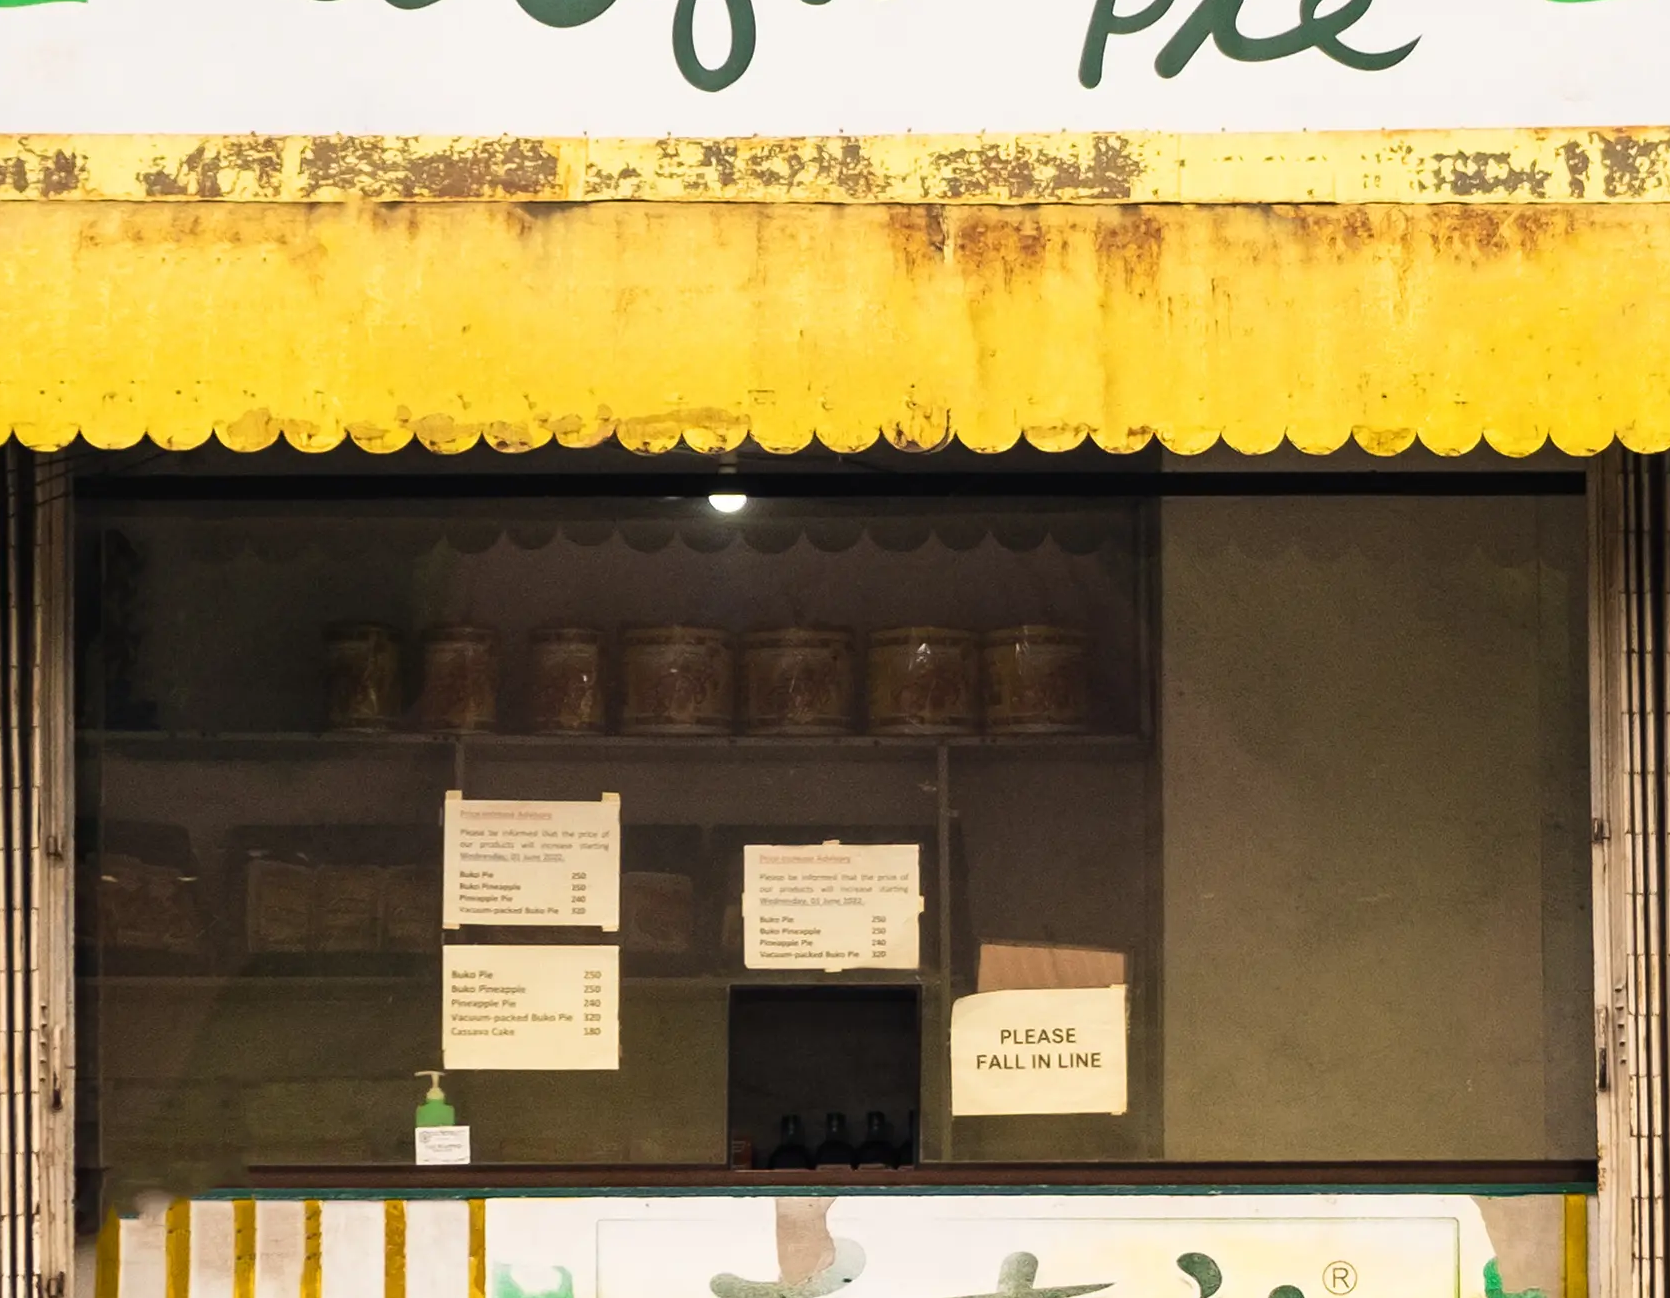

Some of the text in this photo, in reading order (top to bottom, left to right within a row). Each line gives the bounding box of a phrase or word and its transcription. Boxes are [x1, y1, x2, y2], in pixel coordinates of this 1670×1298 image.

[451, 971, 601, 979] Buko Pie 250
[451, 985, 601, 994] Buko Pineapple 250
[451, 999, 601, 1008] Pineapple Pie 240
[451, 1014, 529, 1022] Vacuum-packed
[531, 1014, 555, 1022] Buko
[558, 1014, 573, 1022] Pie
[492, 1028, 515, 1036] Cake
[584, 1028, 601, 1036] 180
[1000, 1028, 1076, 1045] PLEASE
[976, 1052, 1102, 1070] FALL IN LINE
